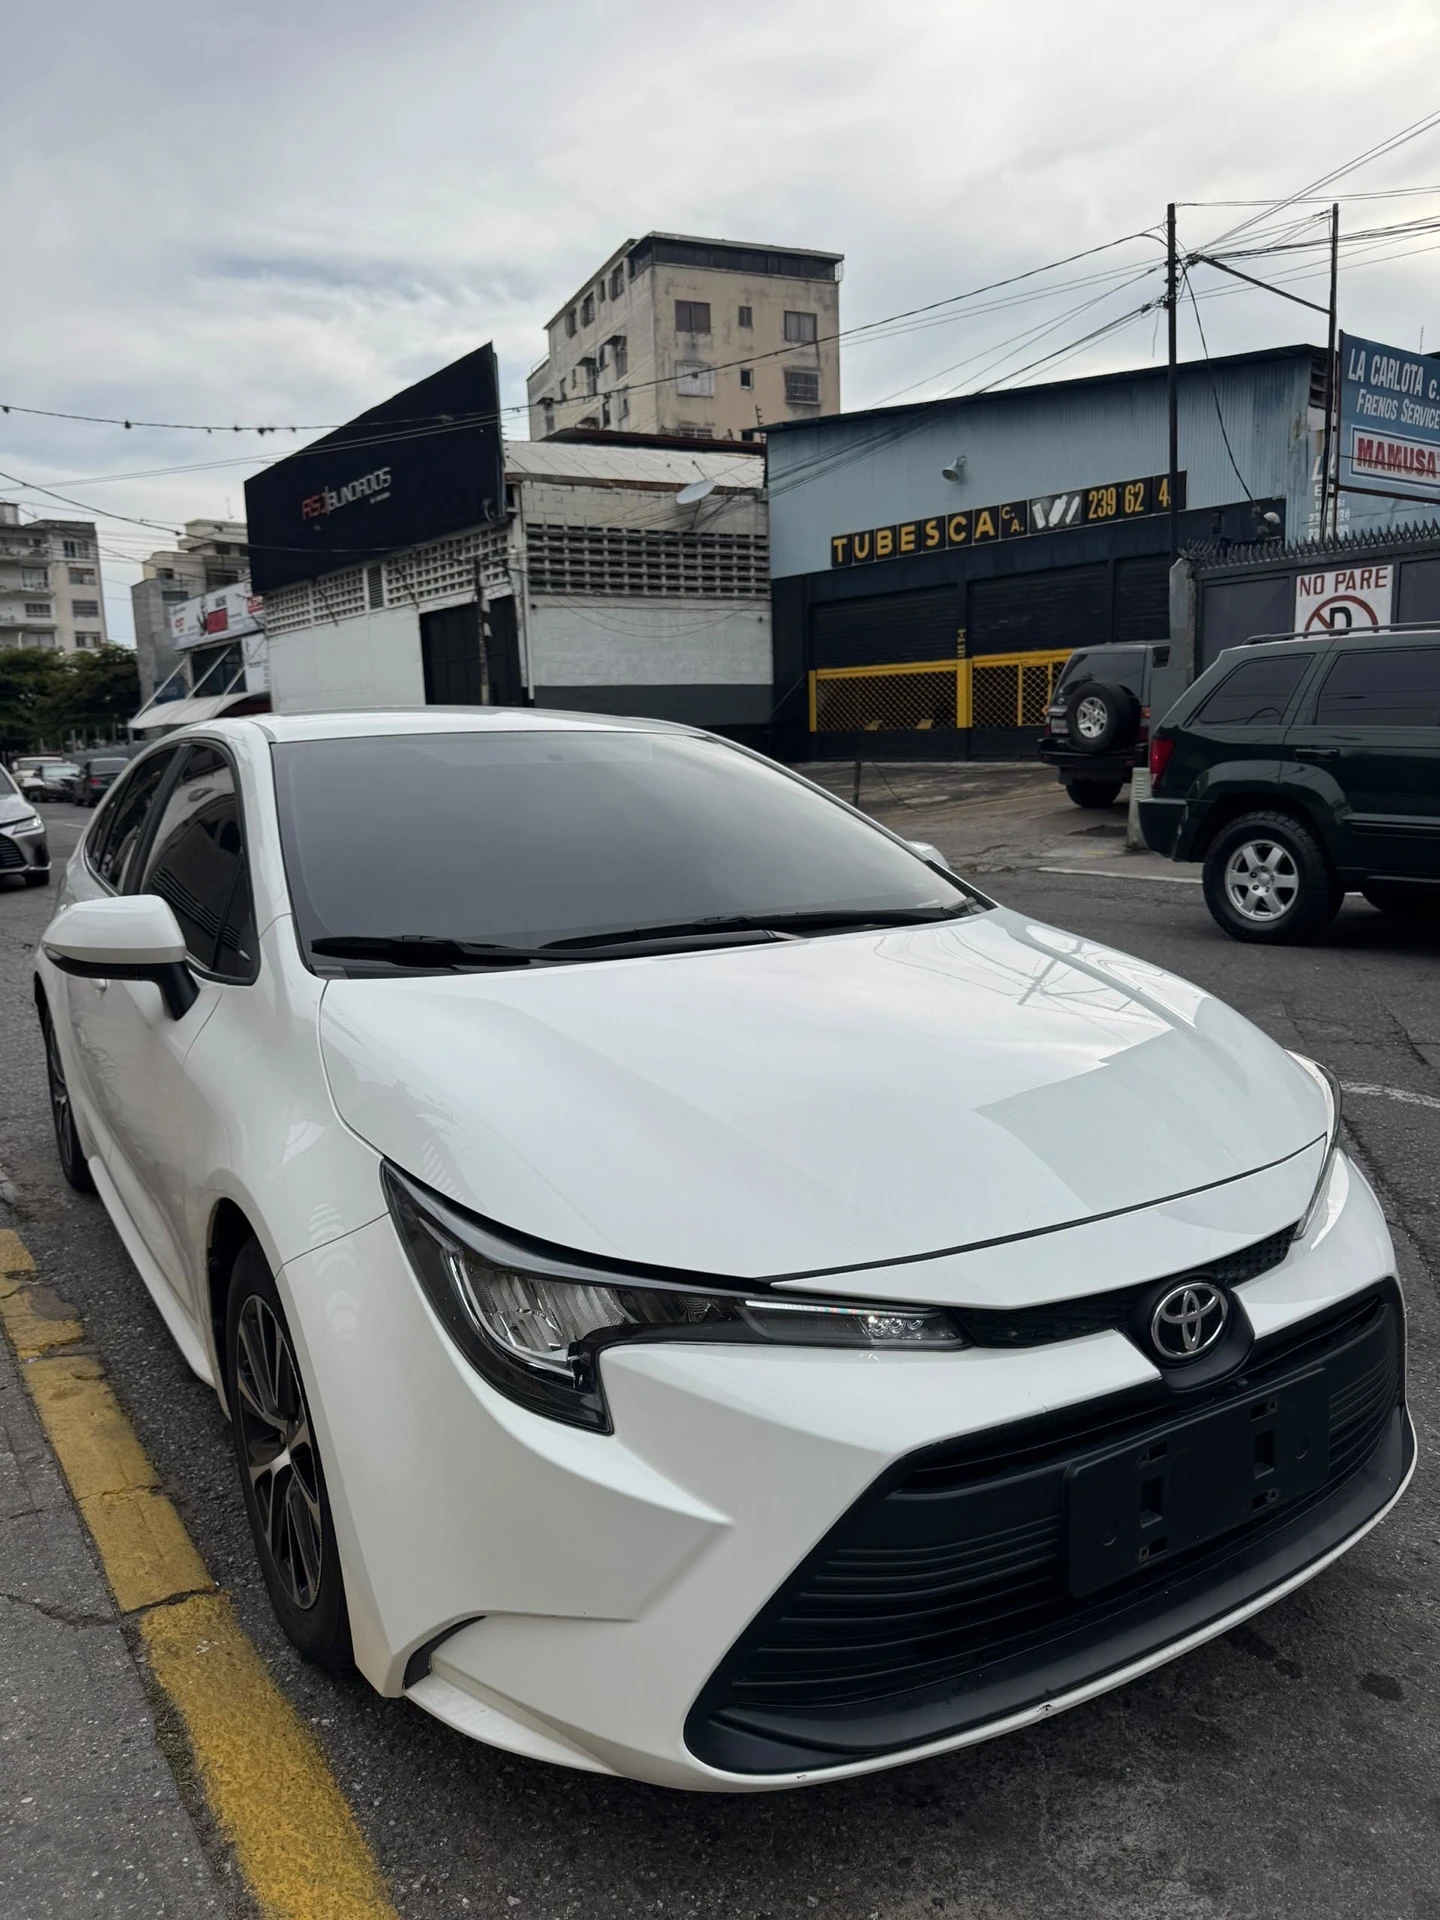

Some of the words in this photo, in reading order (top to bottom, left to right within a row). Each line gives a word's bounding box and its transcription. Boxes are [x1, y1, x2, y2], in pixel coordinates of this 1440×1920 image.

[1348, 348, 1366, 382] LA
[1370, 355, 1424, 396] CARLOTA
[1357, 437, 1437, 479] MAMUSA
[832, 511, 995, 563] TUBESCA
[1087, 487, 1117, 520] 239
[1124, 482, 1144, 514] 62
[1300, 574, 1325, 597] NO
[1334, 567, 1388, 593] PARE
